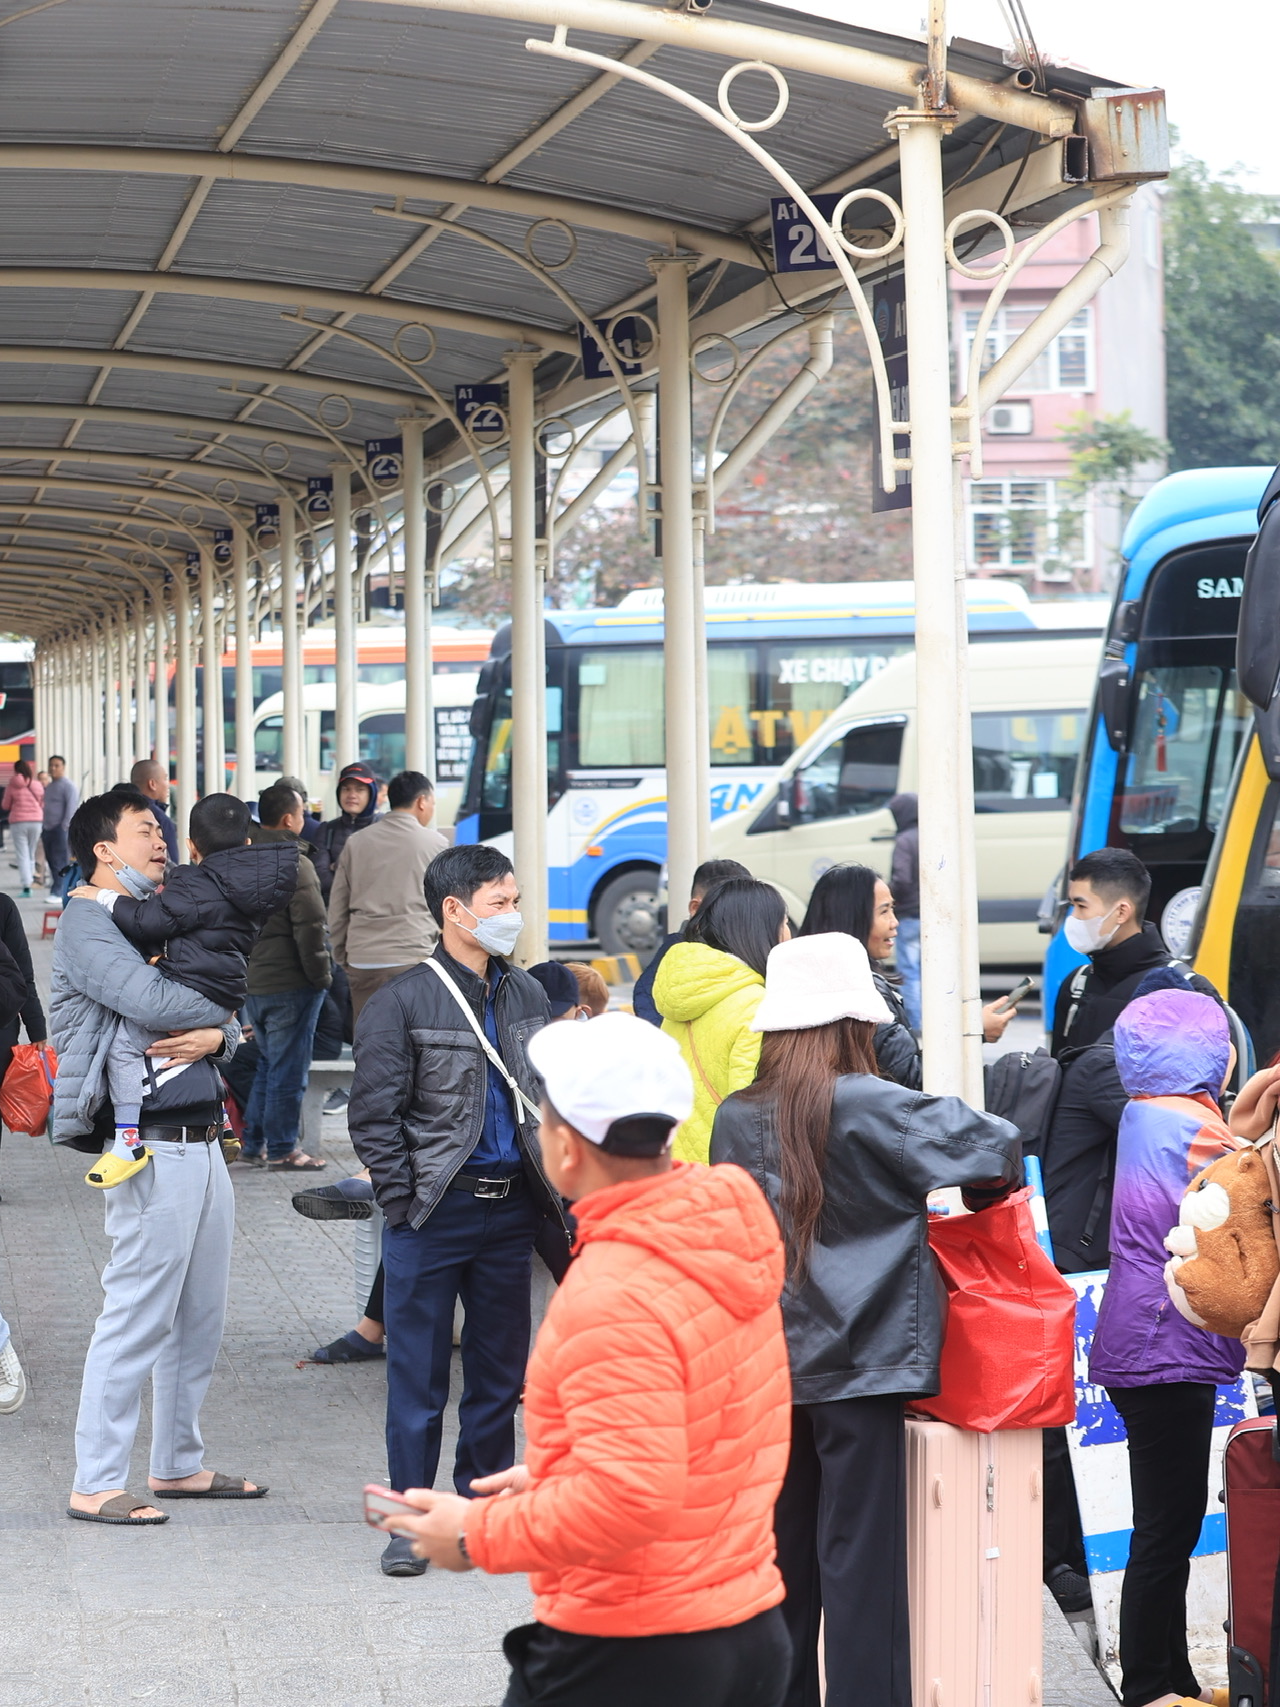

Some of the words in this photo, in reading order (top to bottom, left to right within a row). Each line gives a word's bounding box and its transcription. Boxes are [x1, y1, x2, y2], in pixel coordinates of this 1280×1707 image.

[777, 202, 799, 220] A1
[458, 388, 473, 399] A1
[367, 442, 381, 452] A1
[778, 658, 809, 684] XE
[809, 655, 868, 685] CHẠY
